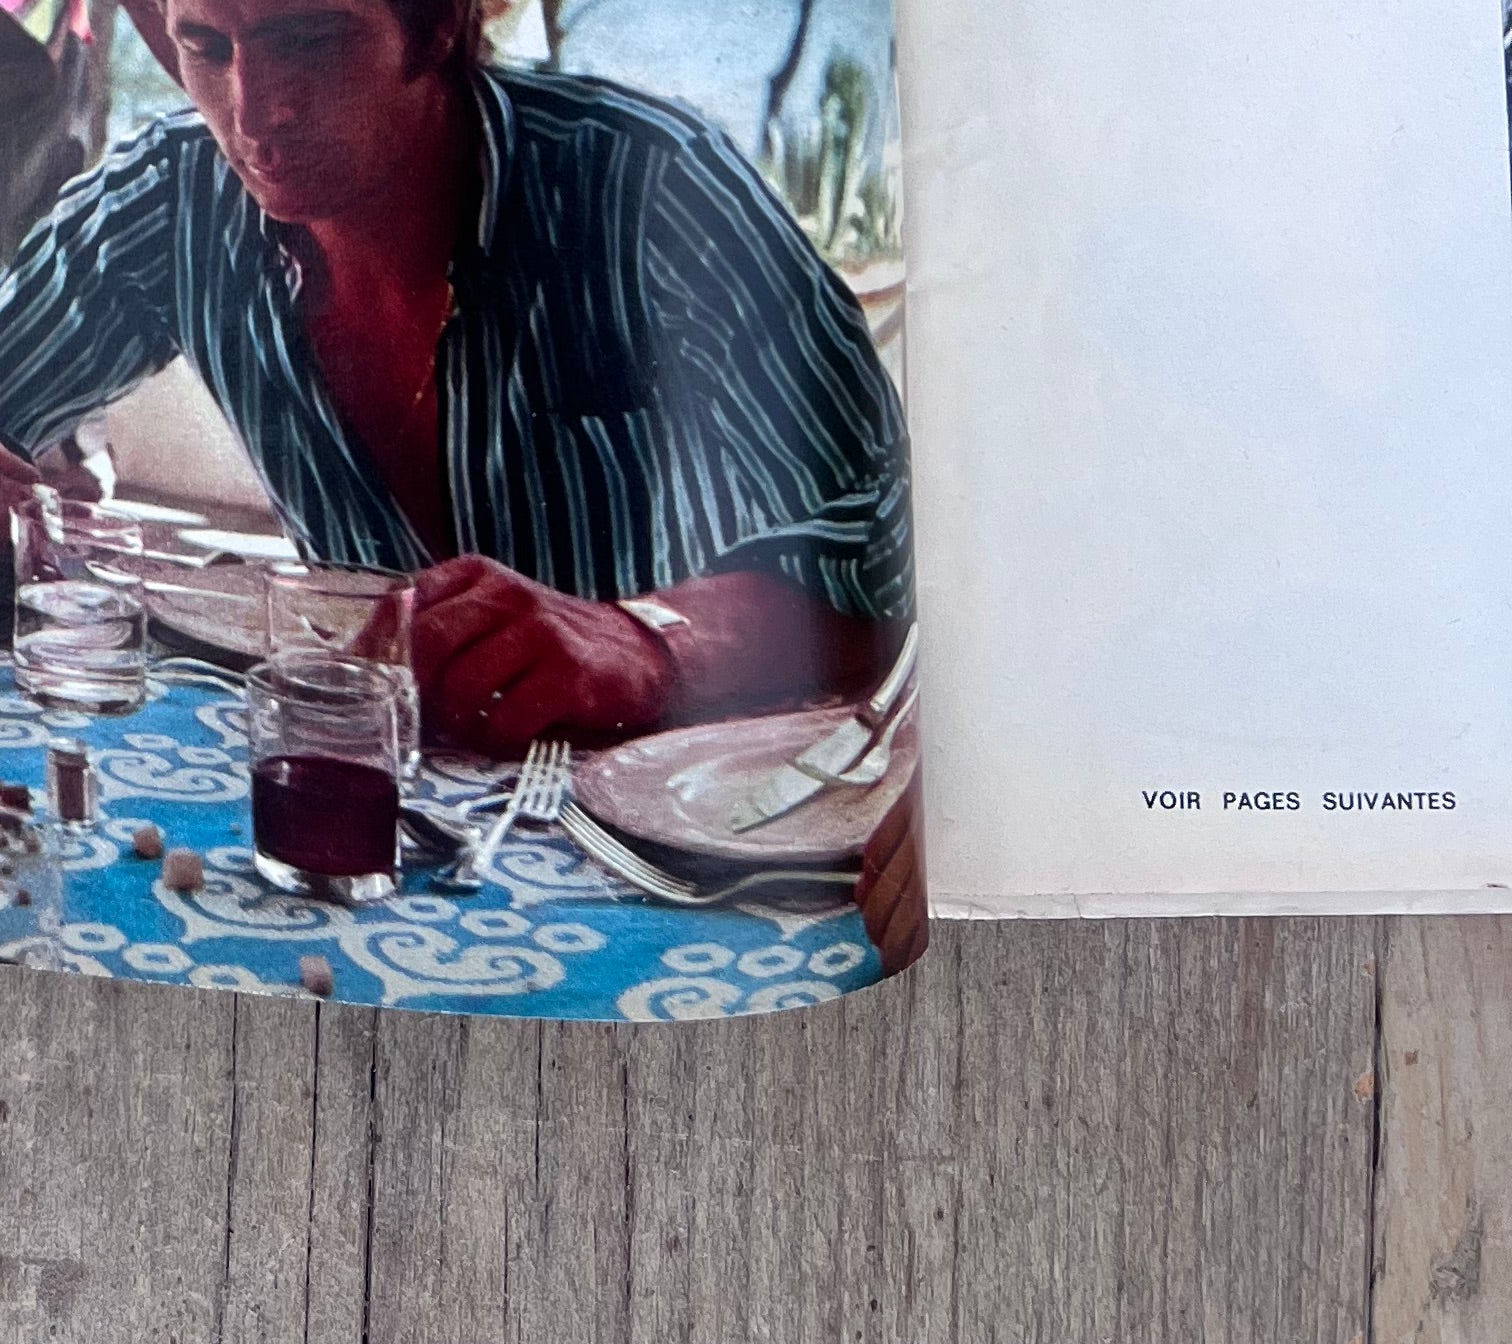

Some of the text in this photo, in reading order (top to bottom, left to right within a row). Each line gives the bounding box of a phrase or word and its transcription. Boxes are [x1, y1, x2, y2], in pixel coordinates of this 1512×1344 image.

[1141, 790, 1457, 811] VOIR PAGES SUIVANTES
